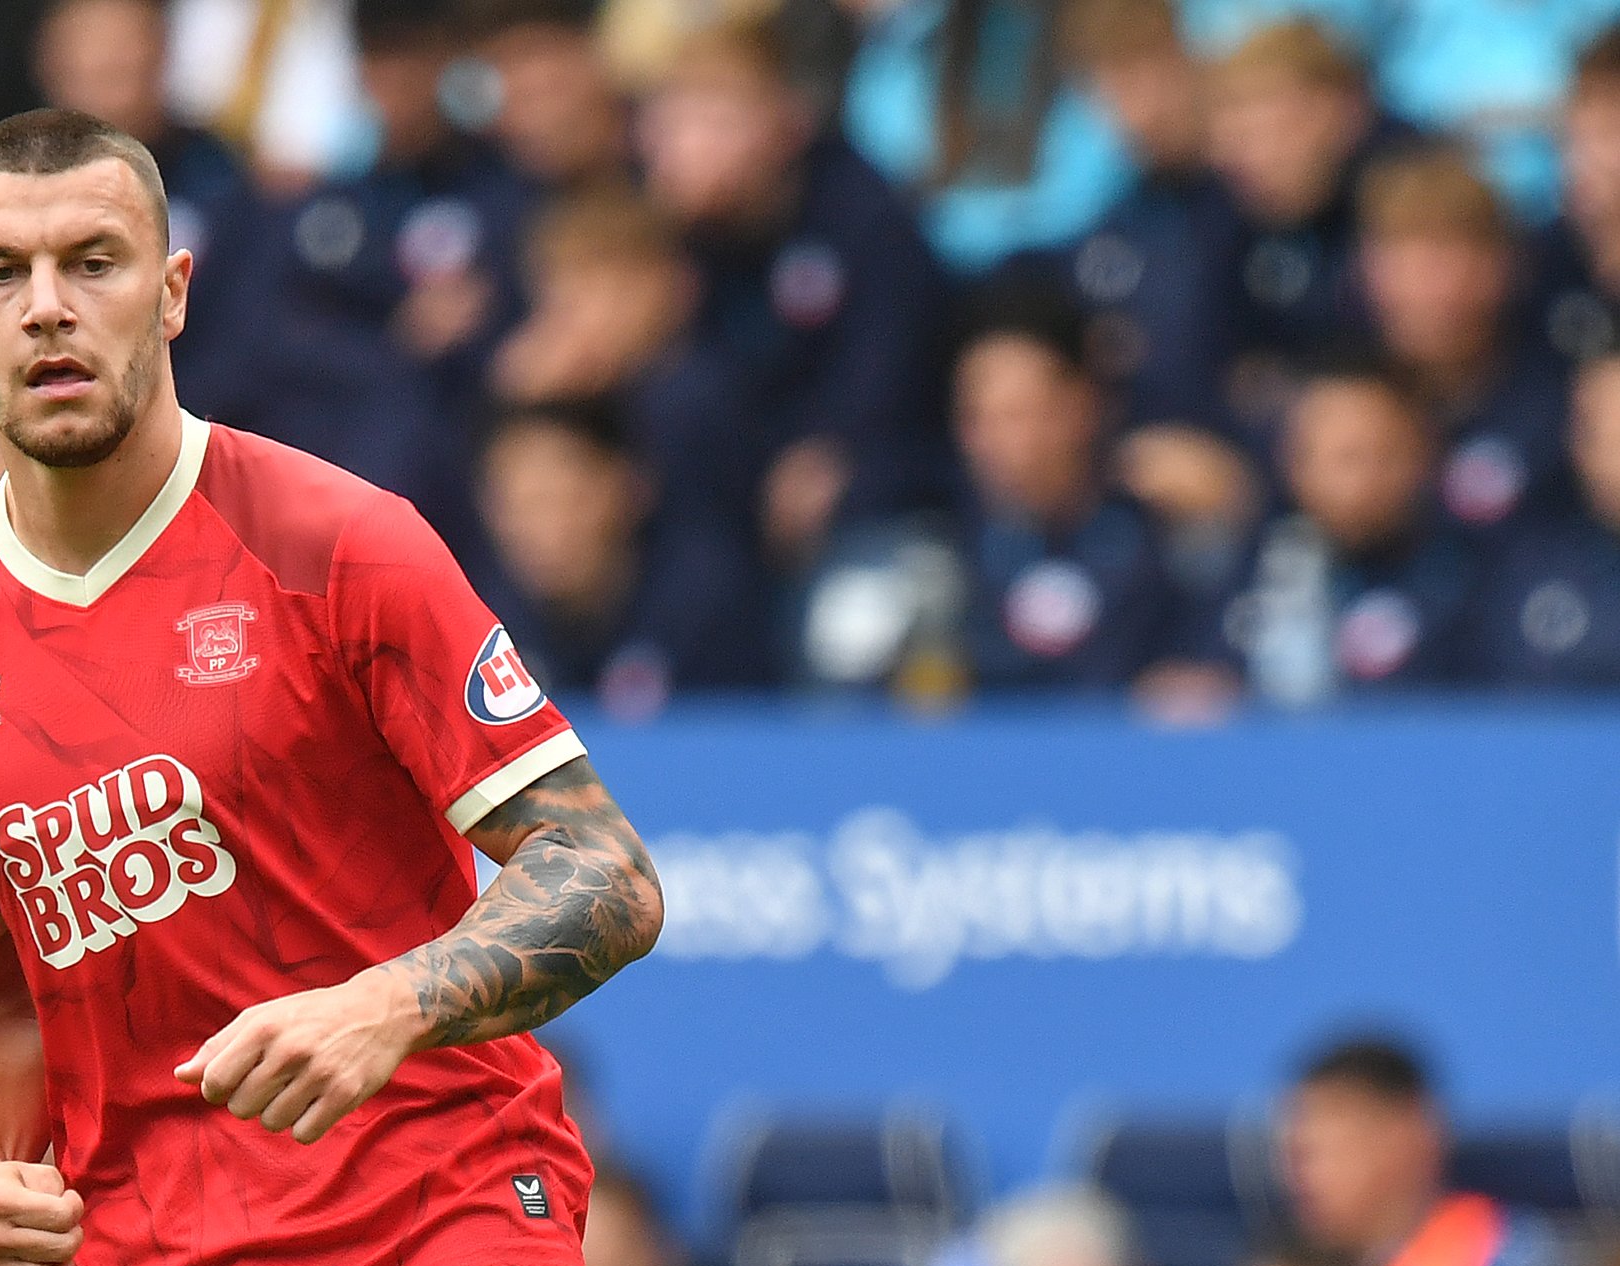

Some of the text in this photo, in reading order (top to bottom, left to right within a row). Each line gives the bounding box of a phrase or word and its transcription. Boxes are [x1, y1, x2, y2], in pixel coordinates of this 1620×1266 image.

[209, 657, 226, 671] PP
[16, 816, 237, 969] BROS
[834, 808, 1300, 990] Systems
